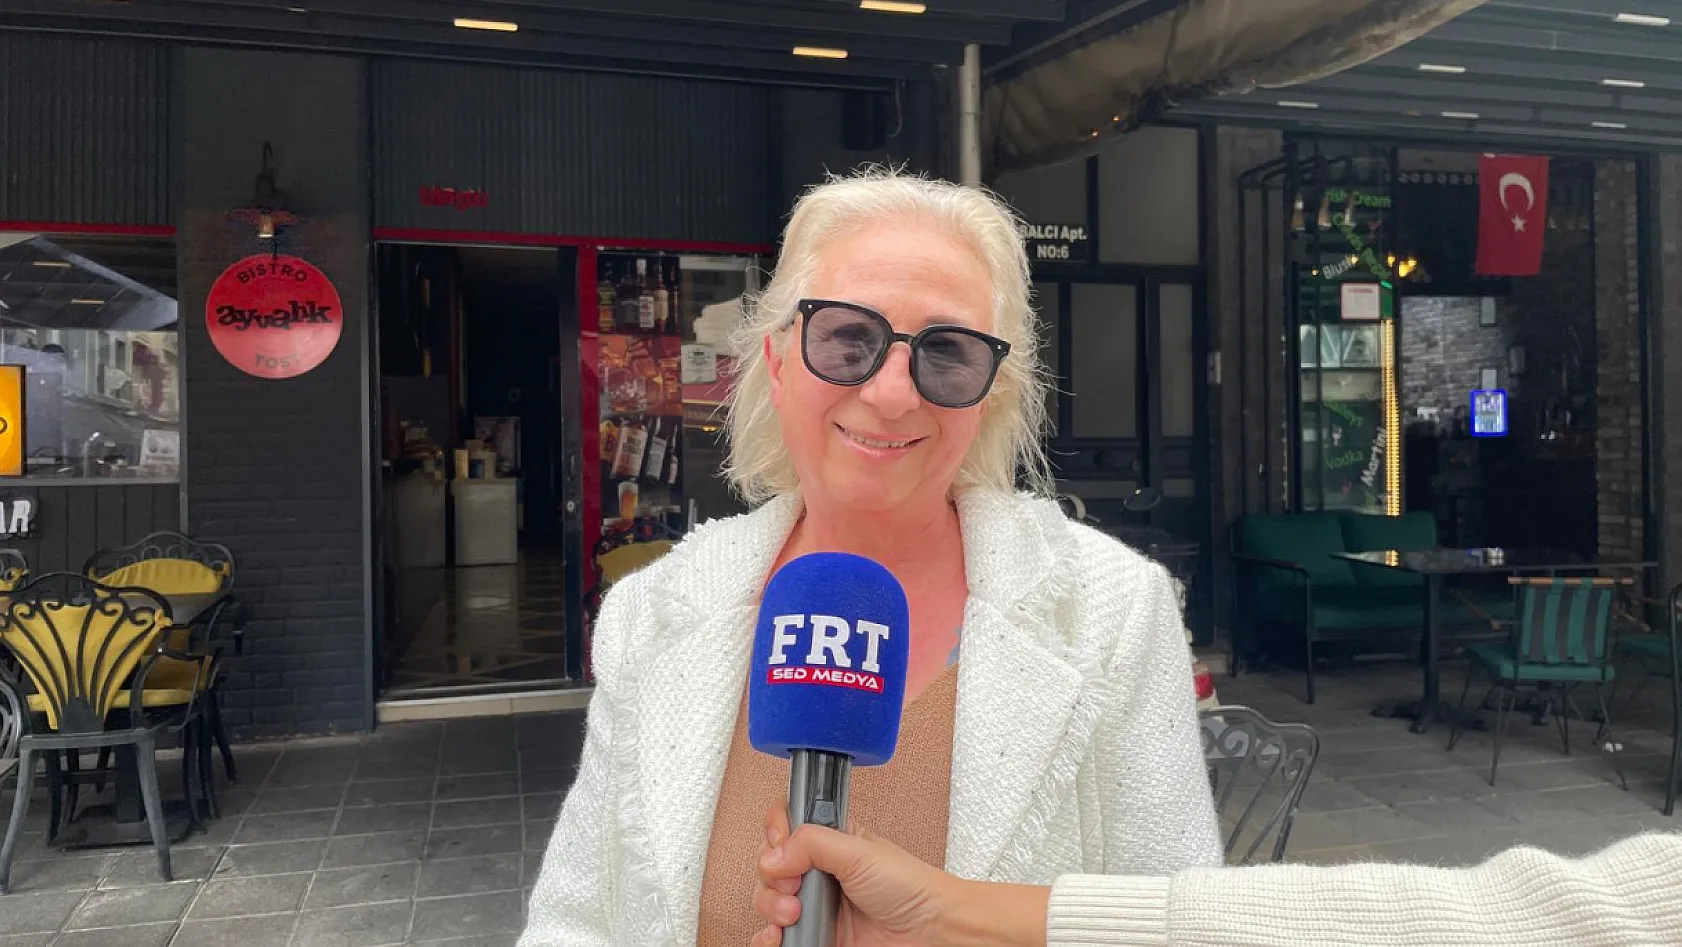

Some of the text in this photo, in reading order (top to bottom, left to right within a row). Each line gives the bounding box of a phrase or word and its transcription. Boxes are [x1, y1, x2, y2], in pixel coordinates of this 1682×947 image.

[1060, 224, 1088, 243] Apt.
[1036, 243, 1070, 259] NO:6
[236, 263, 308, 285] BISTRO
[1360, 426, 1387, 487] Martini
[768, 614, 890, 673] FRT
[772, 668, 879, 689] SED MEDYA
